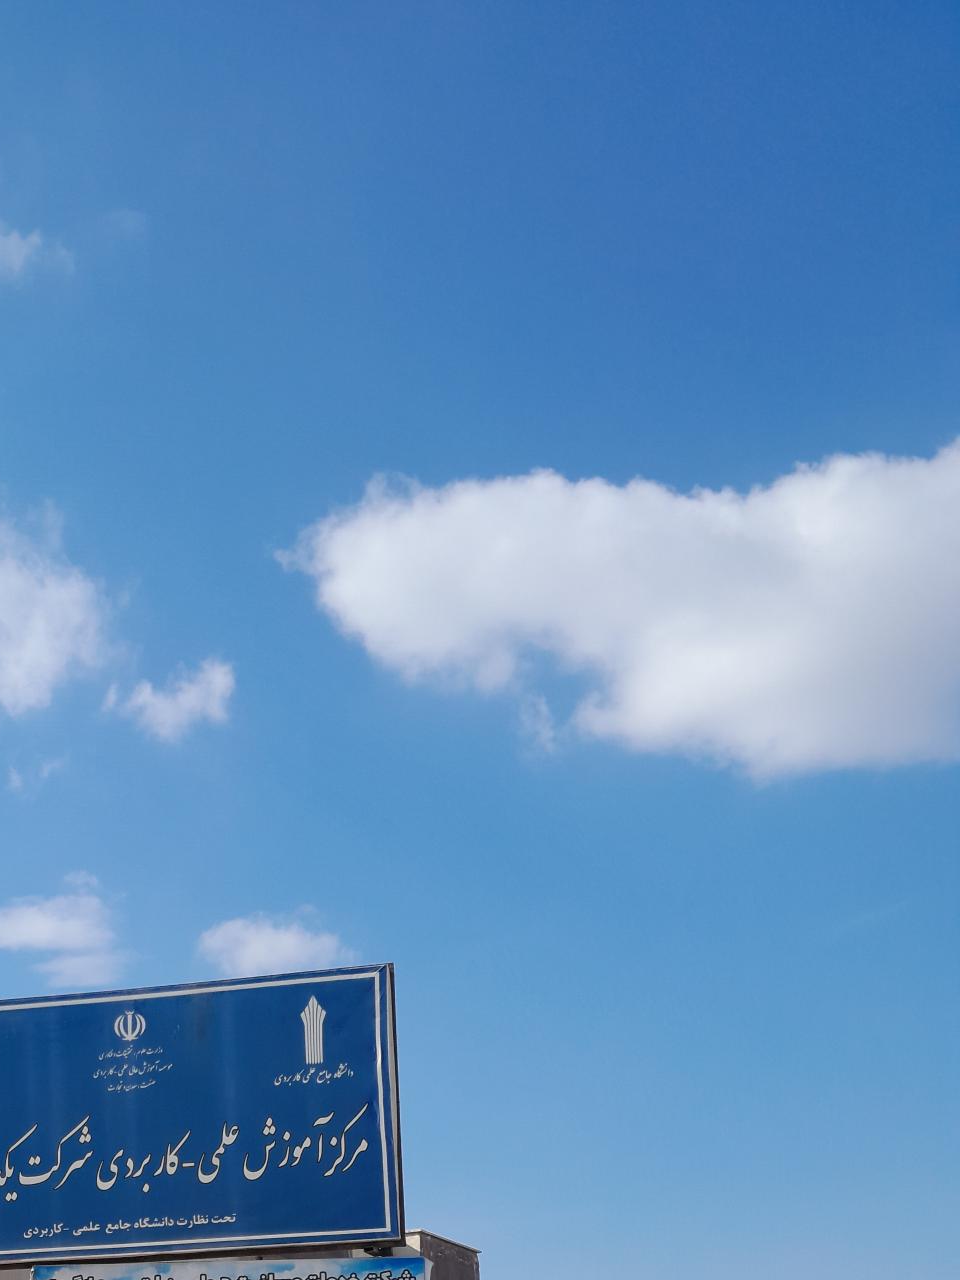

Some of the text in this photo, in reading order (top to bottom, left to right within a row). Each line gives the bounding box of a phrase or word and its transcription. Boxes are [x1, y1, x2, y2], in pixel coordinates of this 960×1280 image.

[302, 1067, 316, 1083] علمی
[317, 1070, 332, 1084] جامع
[334, 1062, 354, 1078] دانشگاه
[243, 1111, 335, 1181] آموزش
[323, 1102, 369, 1177] مرکز
[18, 1115, 94, 1190] شرکت
[197, 1121, 240, 1184] علمی
[134, 1216, 174, 1229] دانشگاه
[176, 1214, 208, 1229] نظارت
[211, 1213, 236, 1224] تحت
[72, 1222, 101, 1236] علمی
[105, 1220, 131, 1234] جامع
